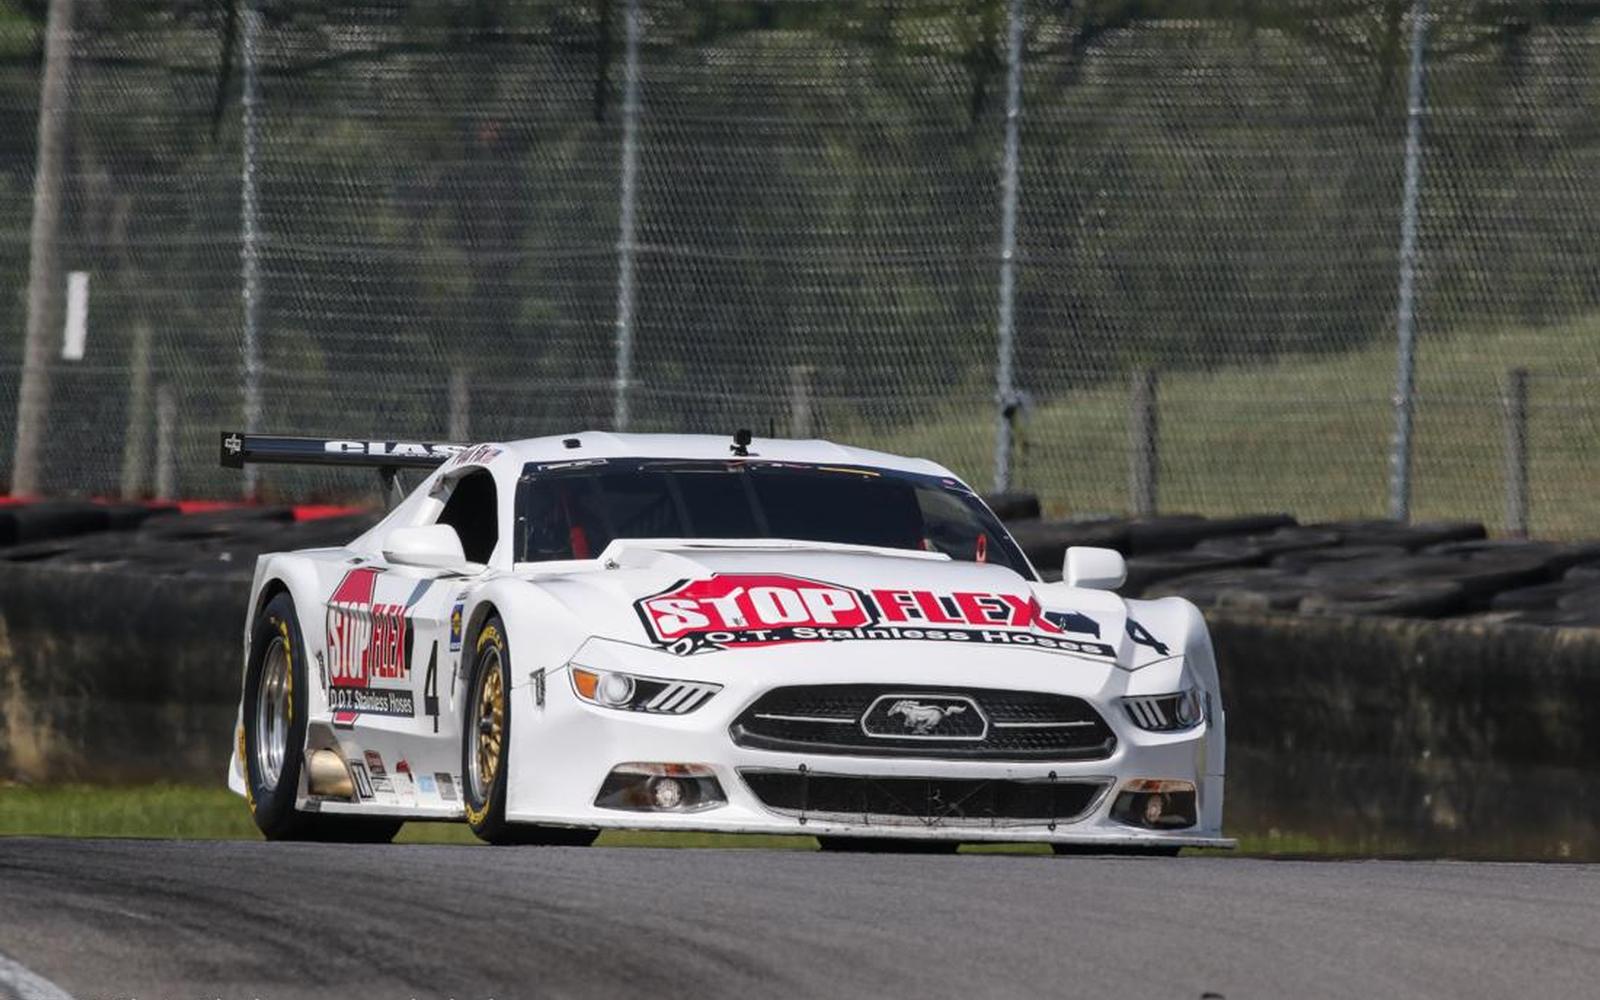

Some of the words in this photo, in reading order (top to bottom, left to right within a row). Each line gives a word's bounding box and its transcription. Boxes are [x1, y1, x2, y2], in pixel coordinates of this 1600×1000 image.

[650, 586, 856, 634] STOP
[871, 588, 1065, 634] FLEX
[328, 600, 371, 680] STOP
[372, 603, 406, 680] FLEX
[665, 628, 780, 656] D.O.T.
[792, 626, 970, 643] Stainless
[984, 630, 1103, 655] Hoses
[1126, 618, 1169, 656] 4
[354, 689, 388, 712] Stainless
[388, 692, 412, 713] Hoses
[424, 639, 440, 733] 4
